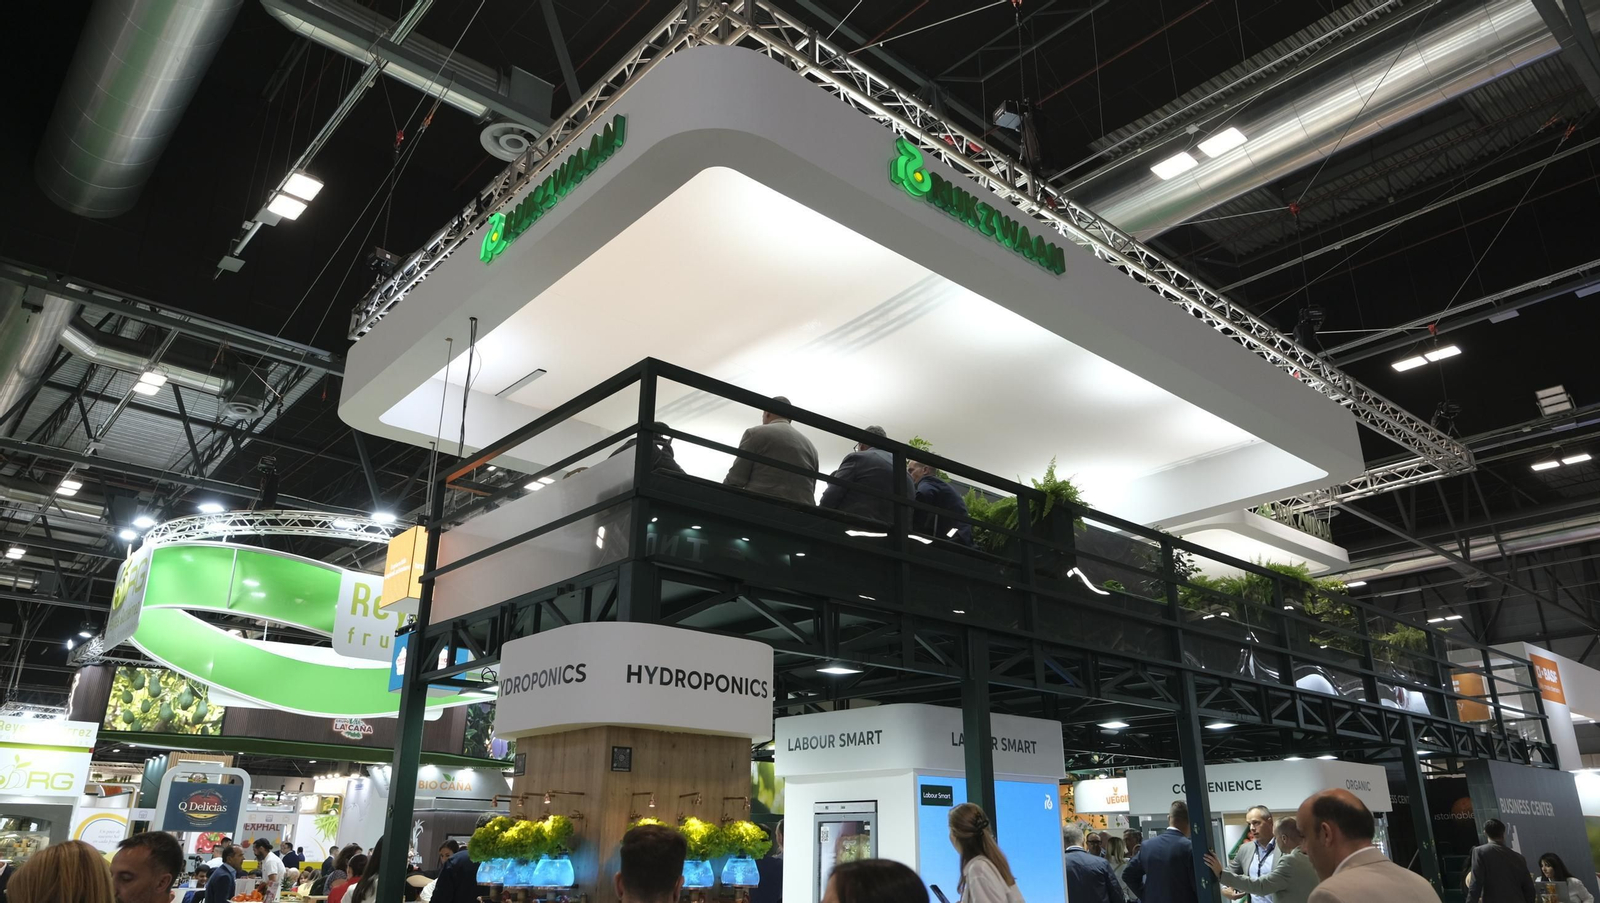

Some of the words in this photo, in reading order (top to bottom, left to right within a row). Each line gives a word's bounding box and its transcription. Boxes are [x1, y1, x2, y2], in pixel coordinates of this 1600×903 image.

[347, 627, 389, 648] fru
[498, 663, 587, 698] YDROPONICS
[626, 664, 768, 699] HYDROPONICS
[788, 734, 835, 751] LABOUR
[839, 730, 883, 747] SMART
[951, 732, 998, 750] LAR
[1001, 737, 1037, 754] SMART
[26, 771, 75, 790] RG
[418, 780, 438, 790] BIO
[1172, 780, 1262, 795] COENIENCE
[1346, 779, 1371, 791] ORGANIC
[178, 801, 188, 813] Q
[189, 801, 228, 813] Delicias
[1435, 811, 1475, 821] stainable
[1500, 798, 1530, 815] BUSINESS
[1531, 800, 1555, 817] CENTER
